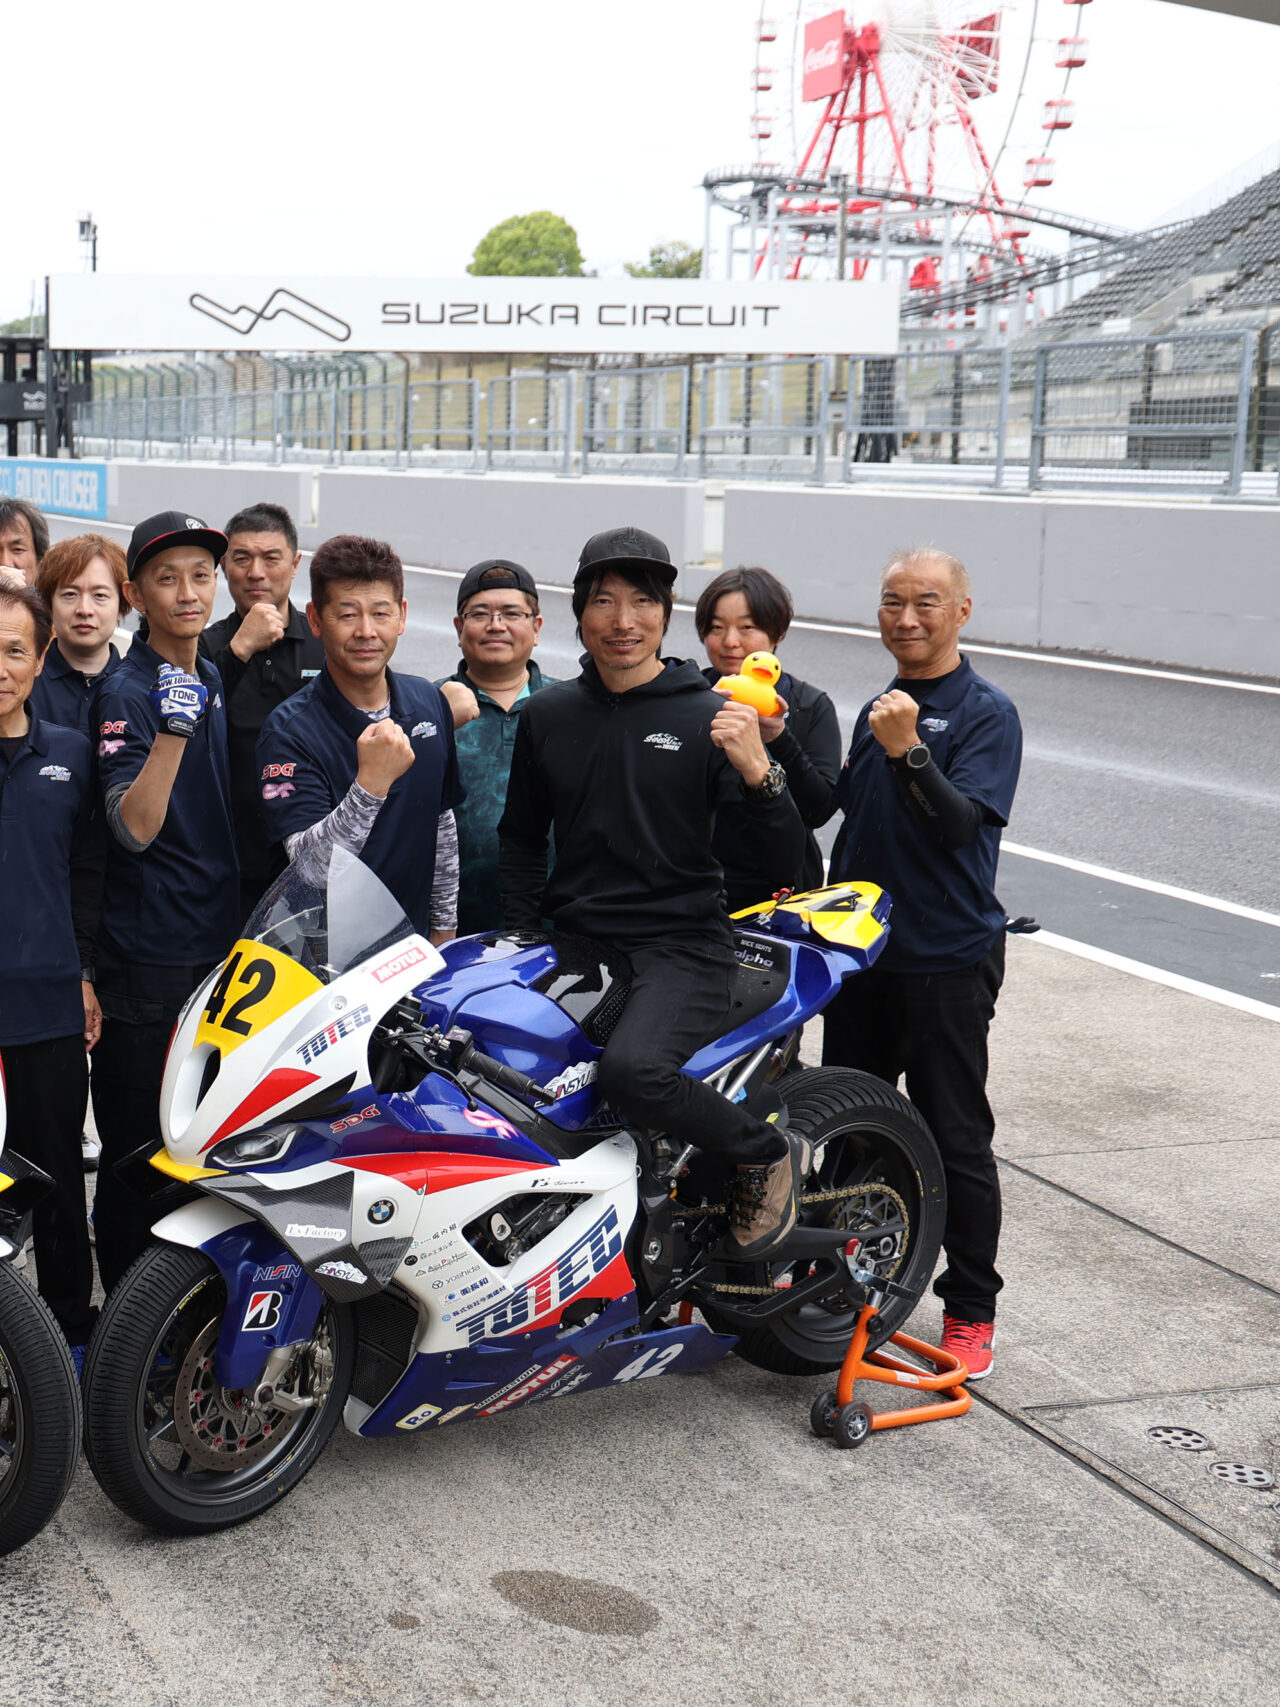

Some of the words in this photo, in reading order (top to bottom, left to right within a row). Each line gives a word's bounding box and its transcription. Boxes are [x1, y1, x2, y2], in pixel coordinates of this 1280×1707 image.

[381, 303, 579, 326] SUZUKA
[598, 304, 780, 327] CIRCUIT
[172, 689, 196, 703] TONE
[376, 949, 425, 981] MOTUL
[734, 949, 774, 967] alpha
[204, 951, 276, 1037] 42
[329, 1103, 382, 1134] SDG
[304, 1224, 345, 1240] Factory
[445, 1264, 481, 1284] yoshida
[612, 1343, 684, 1383] 42
[485, 1357, 573, 1415] MOTUL
